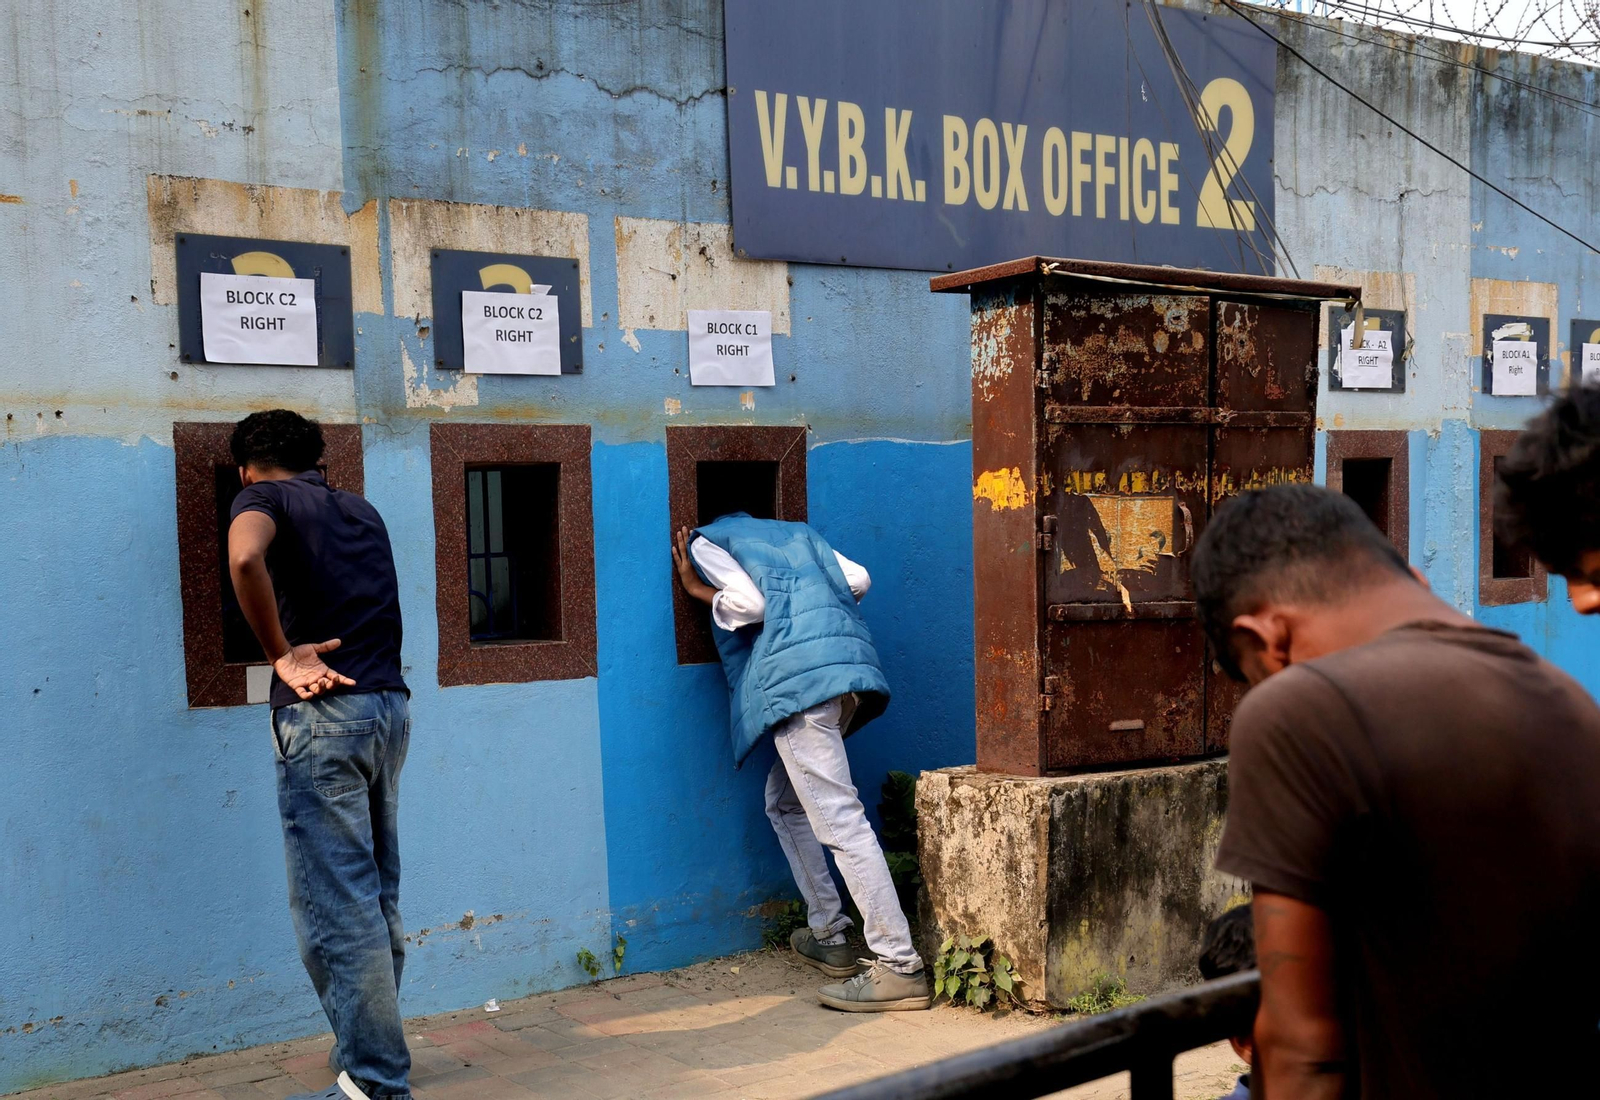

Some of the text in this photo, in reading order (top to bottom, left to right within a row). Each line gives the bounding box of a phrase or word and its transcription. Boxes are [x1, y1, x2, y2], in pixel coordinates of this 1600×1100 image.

[755, 77, 1255, 232] V.Y.B.K. BOX OFFICE 2
[226, 290, 297, 306] BLOCK C2
[484, 305, 543, 320] BLOCK C2
[240, 316, 286, 331] RIGHT
[707, 322, 758, 335] BLOCK C1
[495, 329, 534, 342] RIGHT
[716, 344, 750, 356] RIGHT
[1350, 339, 1371, 348] BCK
[1378, 340, 1388, 349] A2
[1358, 355, 1379, 365] RIGHT
[1502, 350, 1521, 359] BLOCK
[1508, 365, 1523, 376] Right
